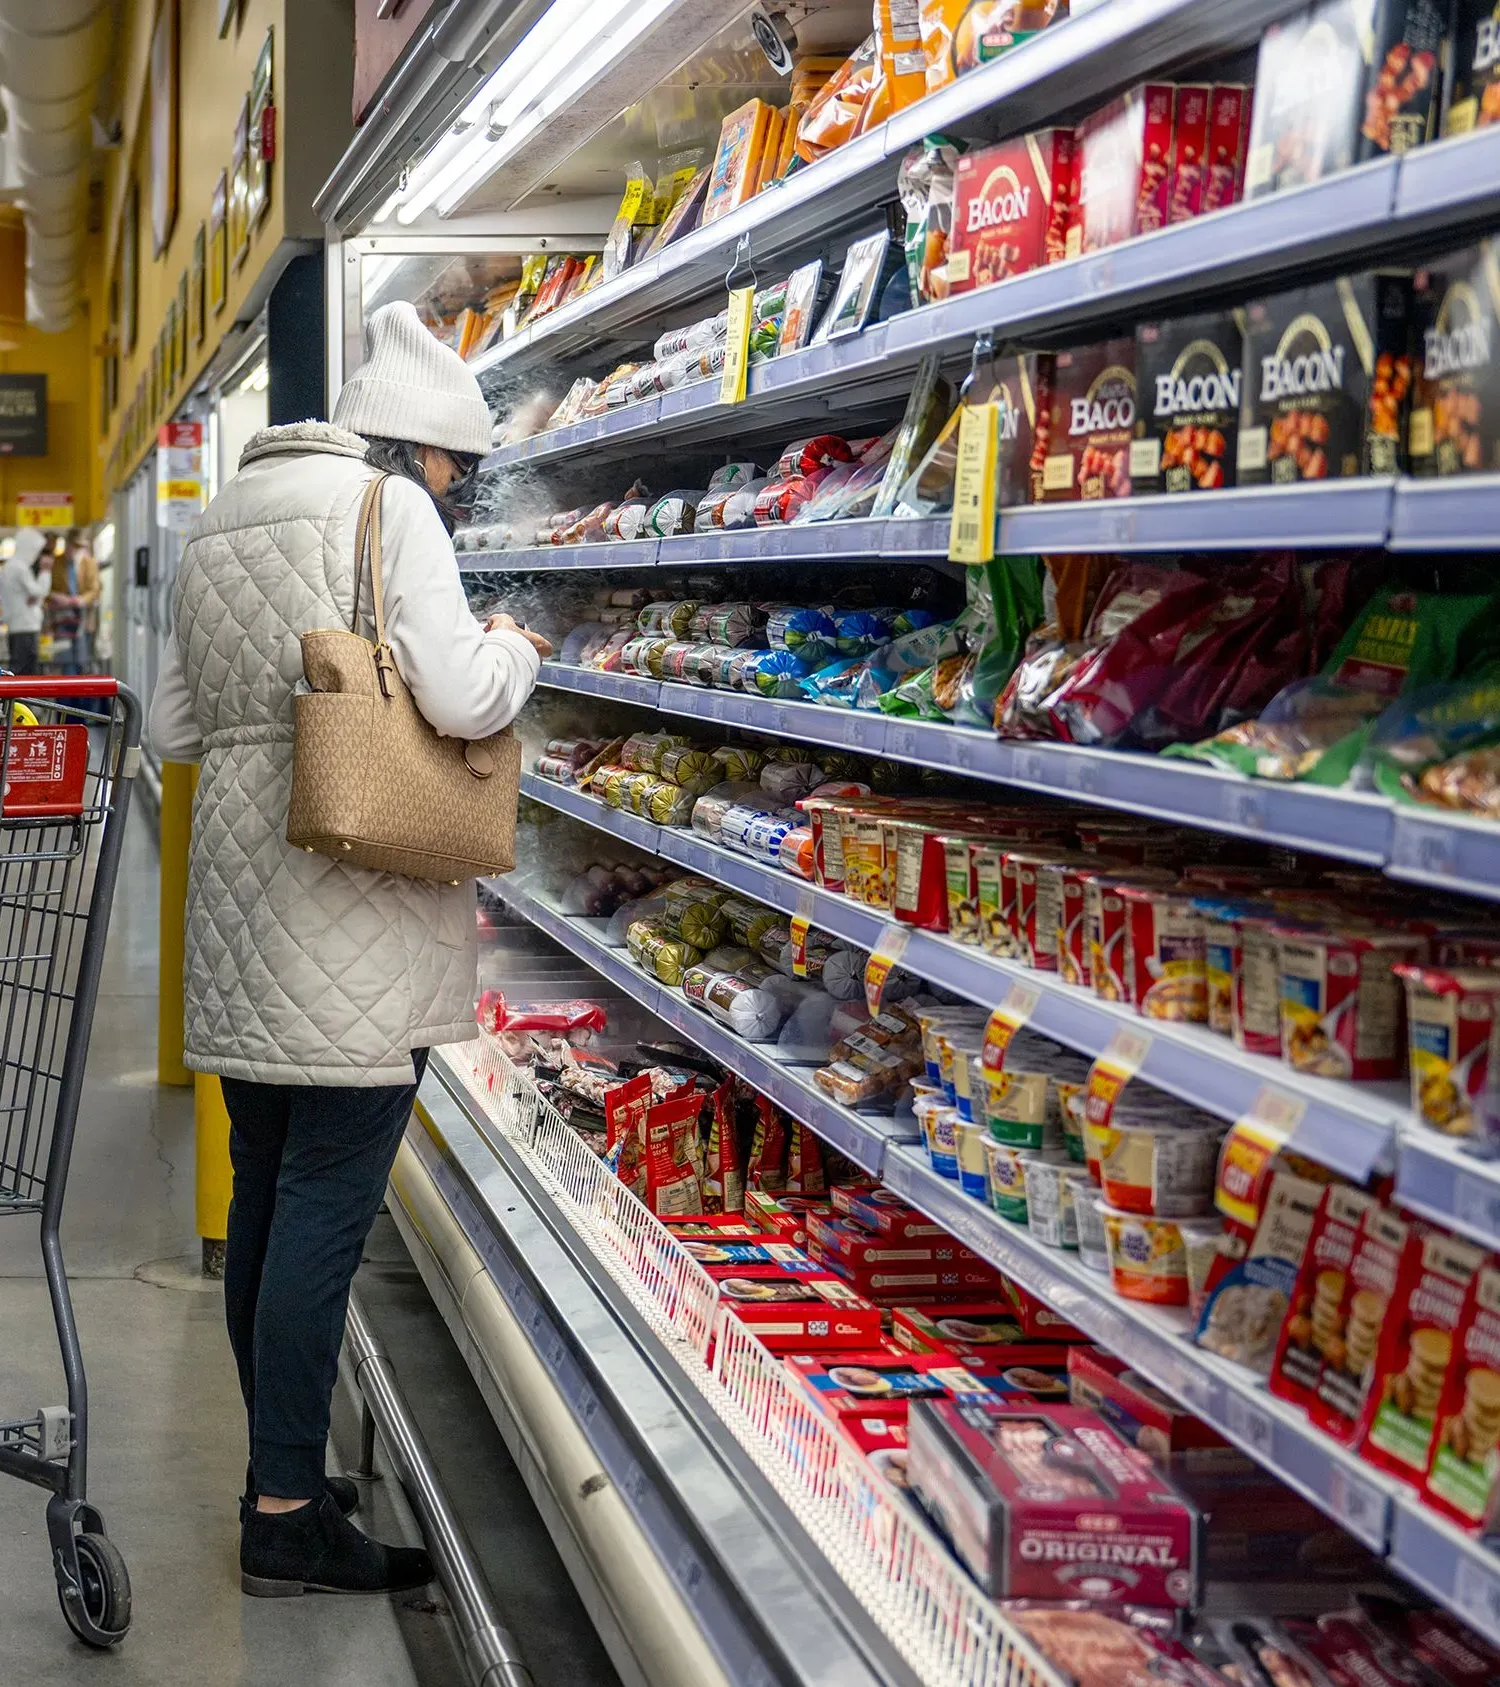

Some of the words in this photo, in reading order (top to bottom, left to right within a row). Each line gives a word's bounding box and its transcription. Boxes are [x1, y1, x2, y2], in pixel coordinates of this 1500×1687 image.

[967, 187, 1030, 233] BACON
[1424, 316, 1491, 380] BACON
[1154, 368, 1242, 416] BACON
[1261, 345, 1344, 400] BACON
[1069, 398, 1135, 436] BACO
[53, 741, 65, 779] AVISO
[1019, 1538, 1179, 1568] ORIGINAL
[1172, 1576, 1186, 1589] 3
